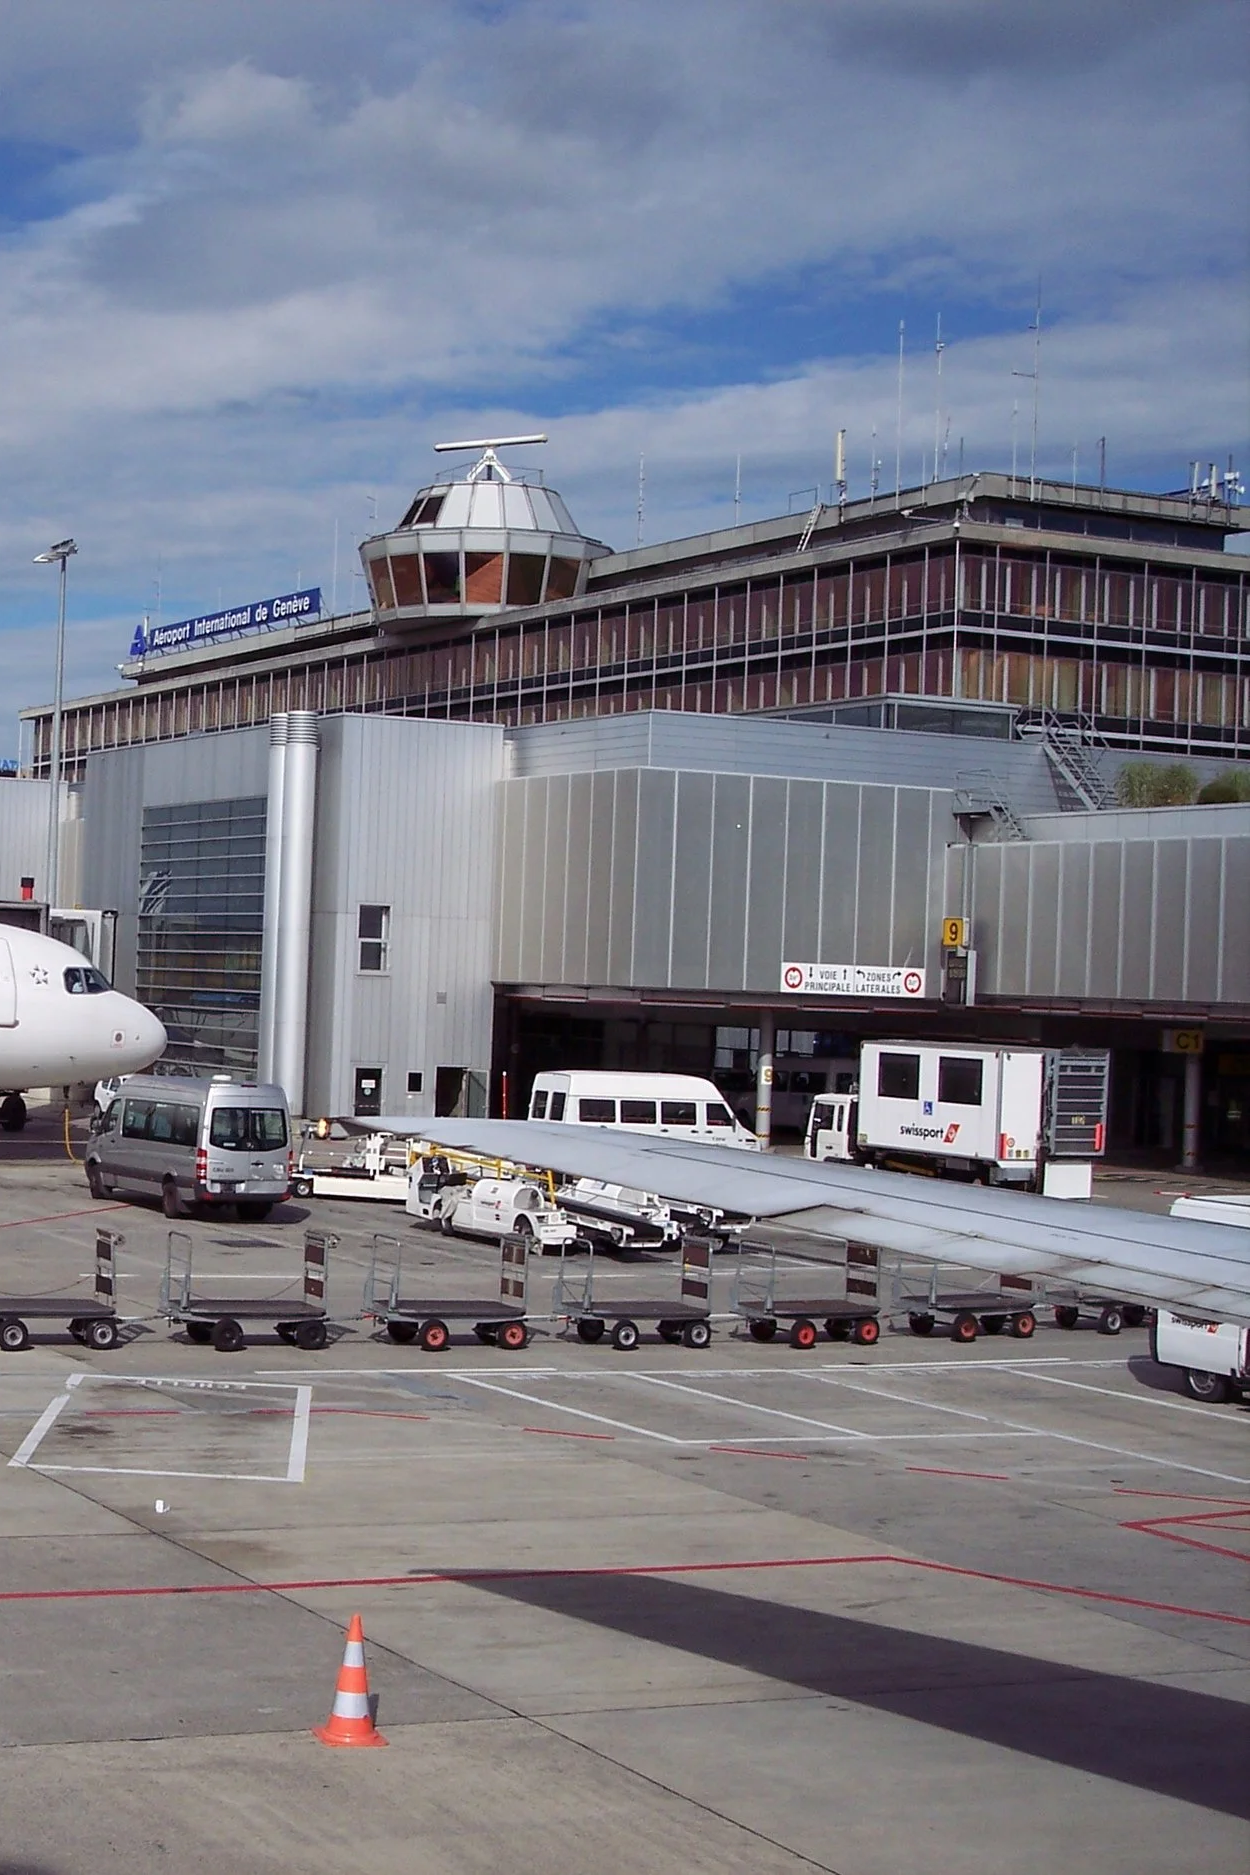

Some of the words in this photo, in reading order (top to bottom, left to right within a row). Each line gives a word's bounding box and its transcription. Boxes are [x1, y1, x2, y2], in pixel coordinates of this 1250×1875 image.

[153, 625, 190, 646] Aéroport
[194, 607, 251, 637] International
[255, 604, 268, 622] de
[273, 595, 310, 618] Genève
[949, 922, 958, 942] 9
[819, 970, 837, 980] VOIE
[866, 972, 892, 983] ZONES
[804, 982, 851, 993] PRINCIPALE
[856, 984, 901, 995] LATERALES
[1177, 1032, 1200, 1050] C1
[900, 1123, 944, 1140] swissport
